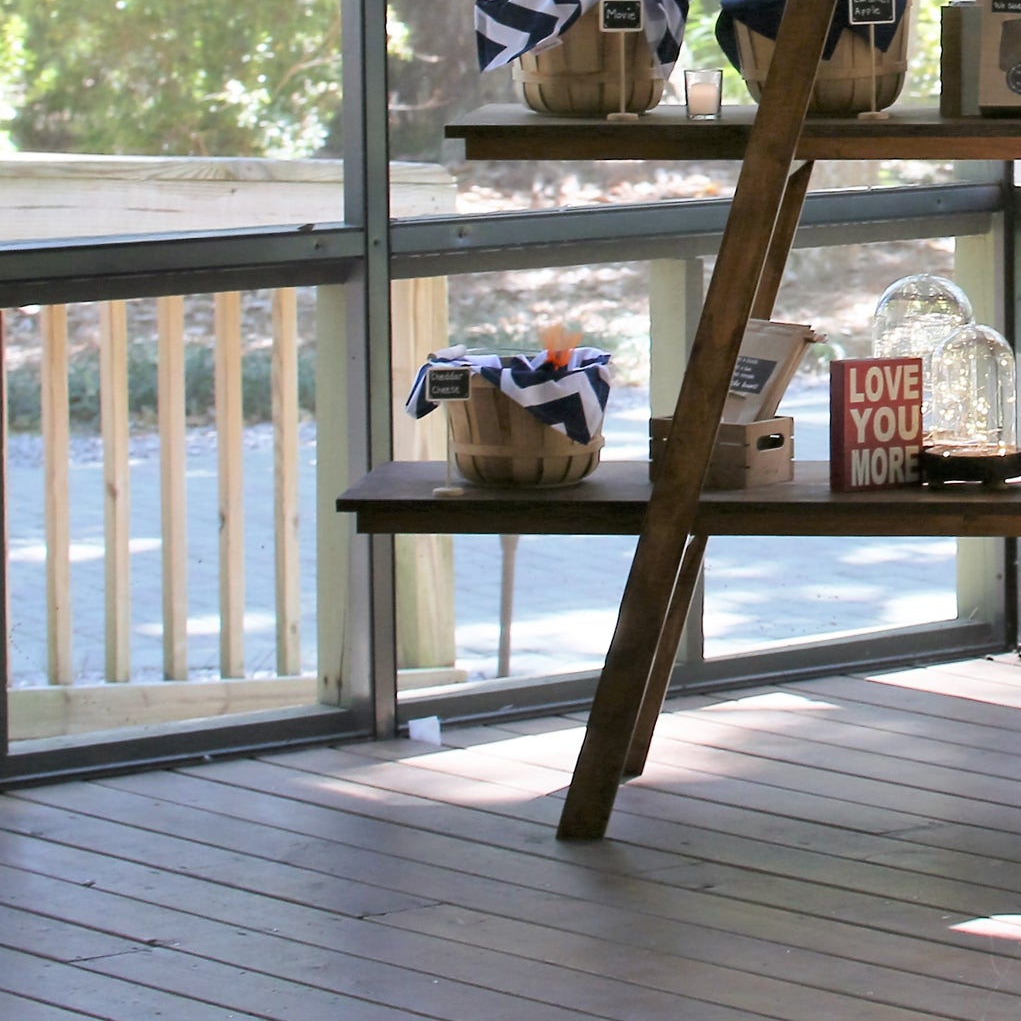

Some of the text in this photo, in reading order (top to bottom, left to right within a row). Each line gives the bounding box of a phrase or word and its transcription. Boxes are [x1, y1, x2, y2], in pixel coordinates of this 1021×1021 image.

[606, 7, 636, 20] Movie
[854, 6, 881, 16] Apple
[849, 365, 919, 403] LOVE
[849, 405, 919, 444] YOU
[851, 445, 919, 487] MORE
